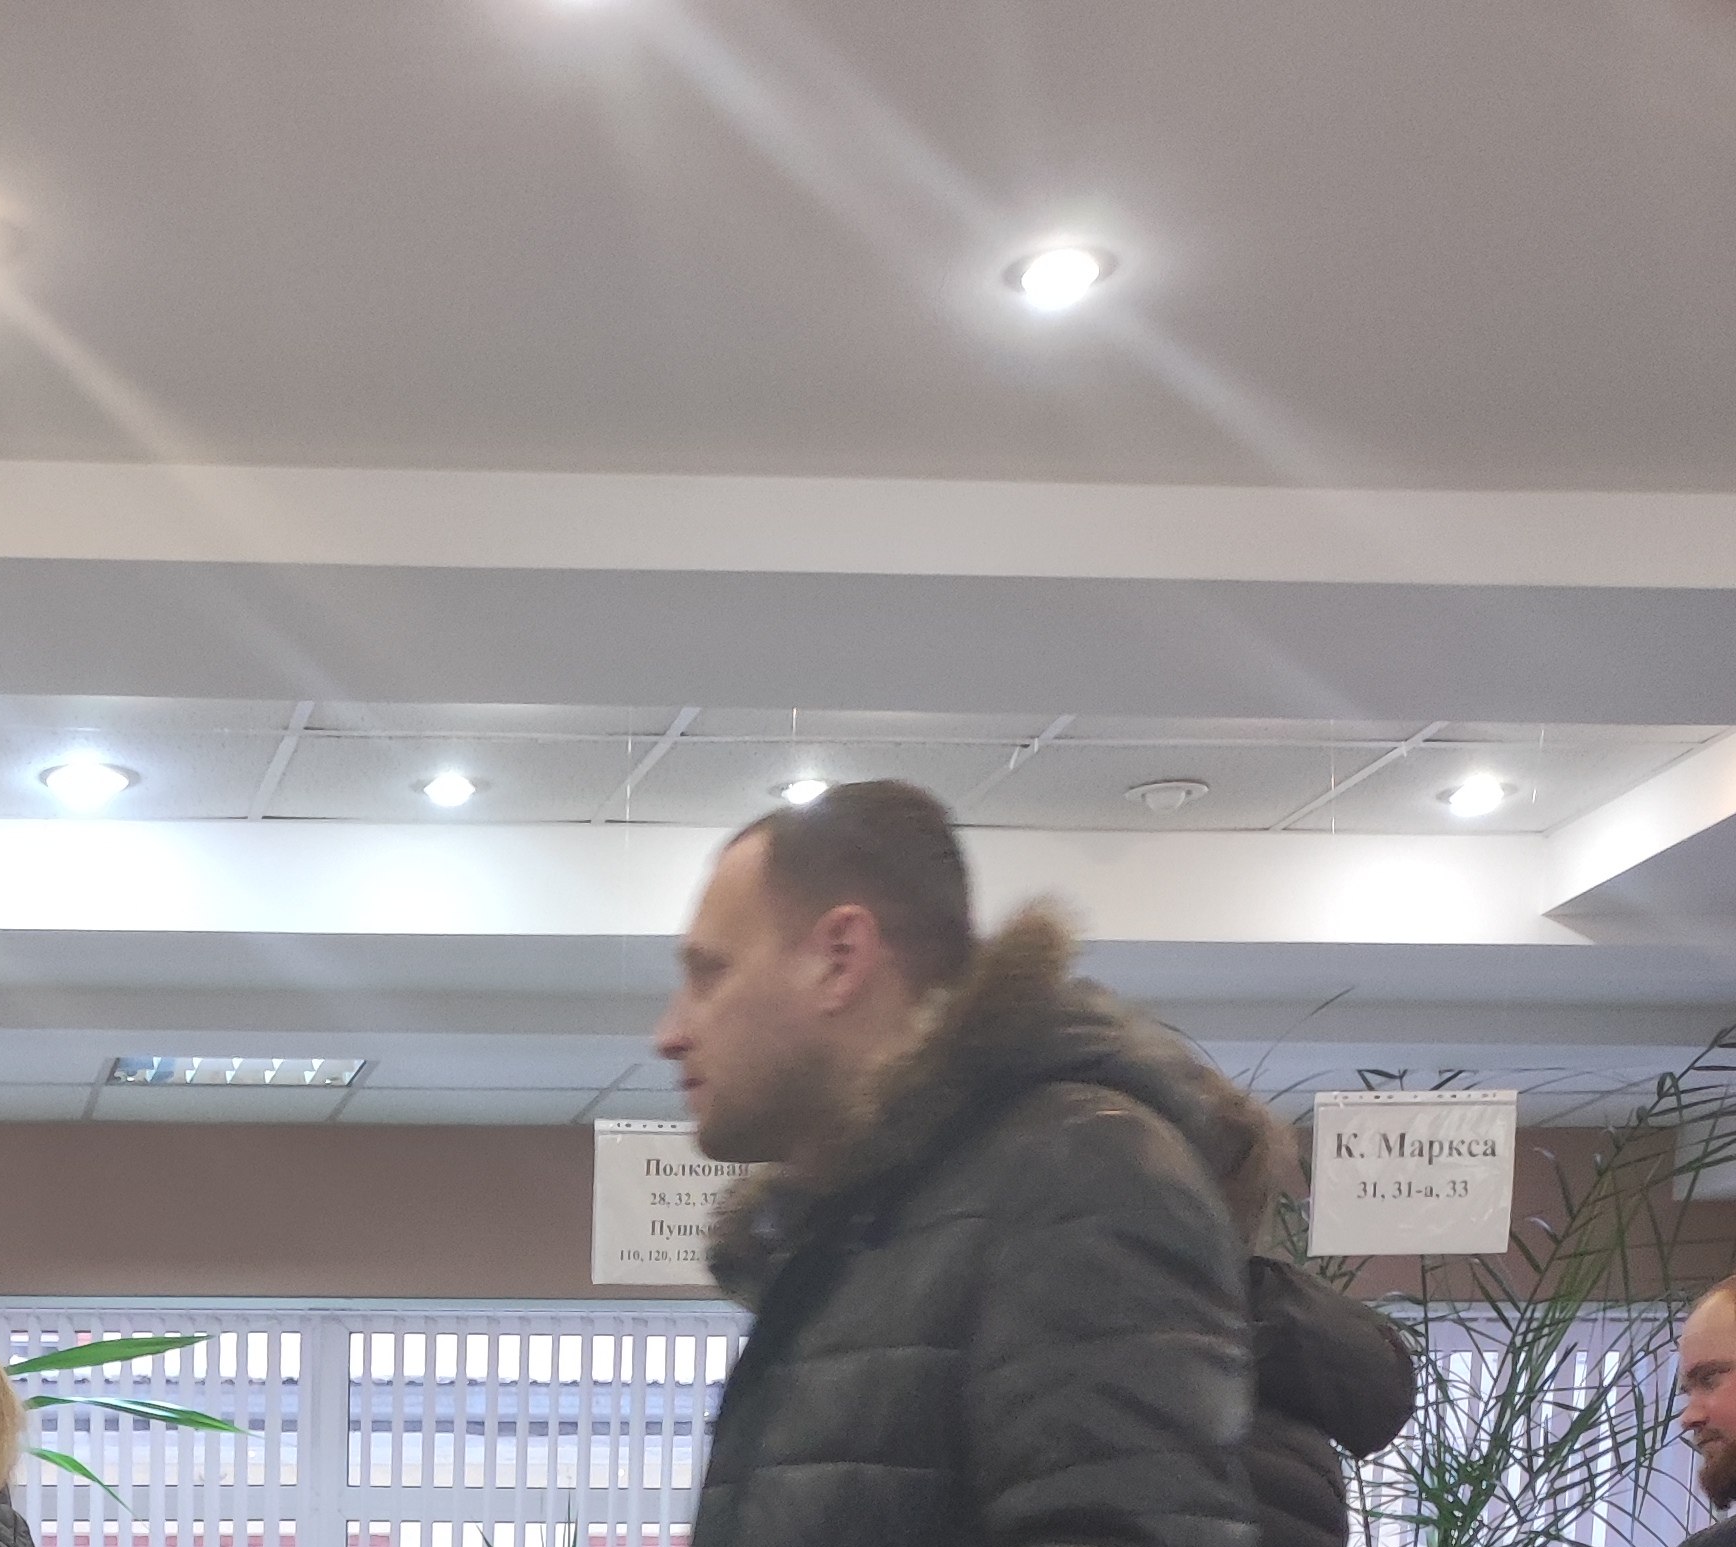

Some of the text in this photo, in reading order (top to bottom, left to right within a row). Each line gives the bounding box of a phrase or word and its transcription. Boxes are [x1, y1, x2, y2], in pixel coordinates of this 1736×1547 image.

[1335, 1132, 1497, 1166] К. Маркса
[645, 1158, 750, 1177] Полковая
[1446, 1179, 1468, 1198] 33
[650, 1192, 671, 1207] 28,
[675, 1192, 696, 1207] 32,
